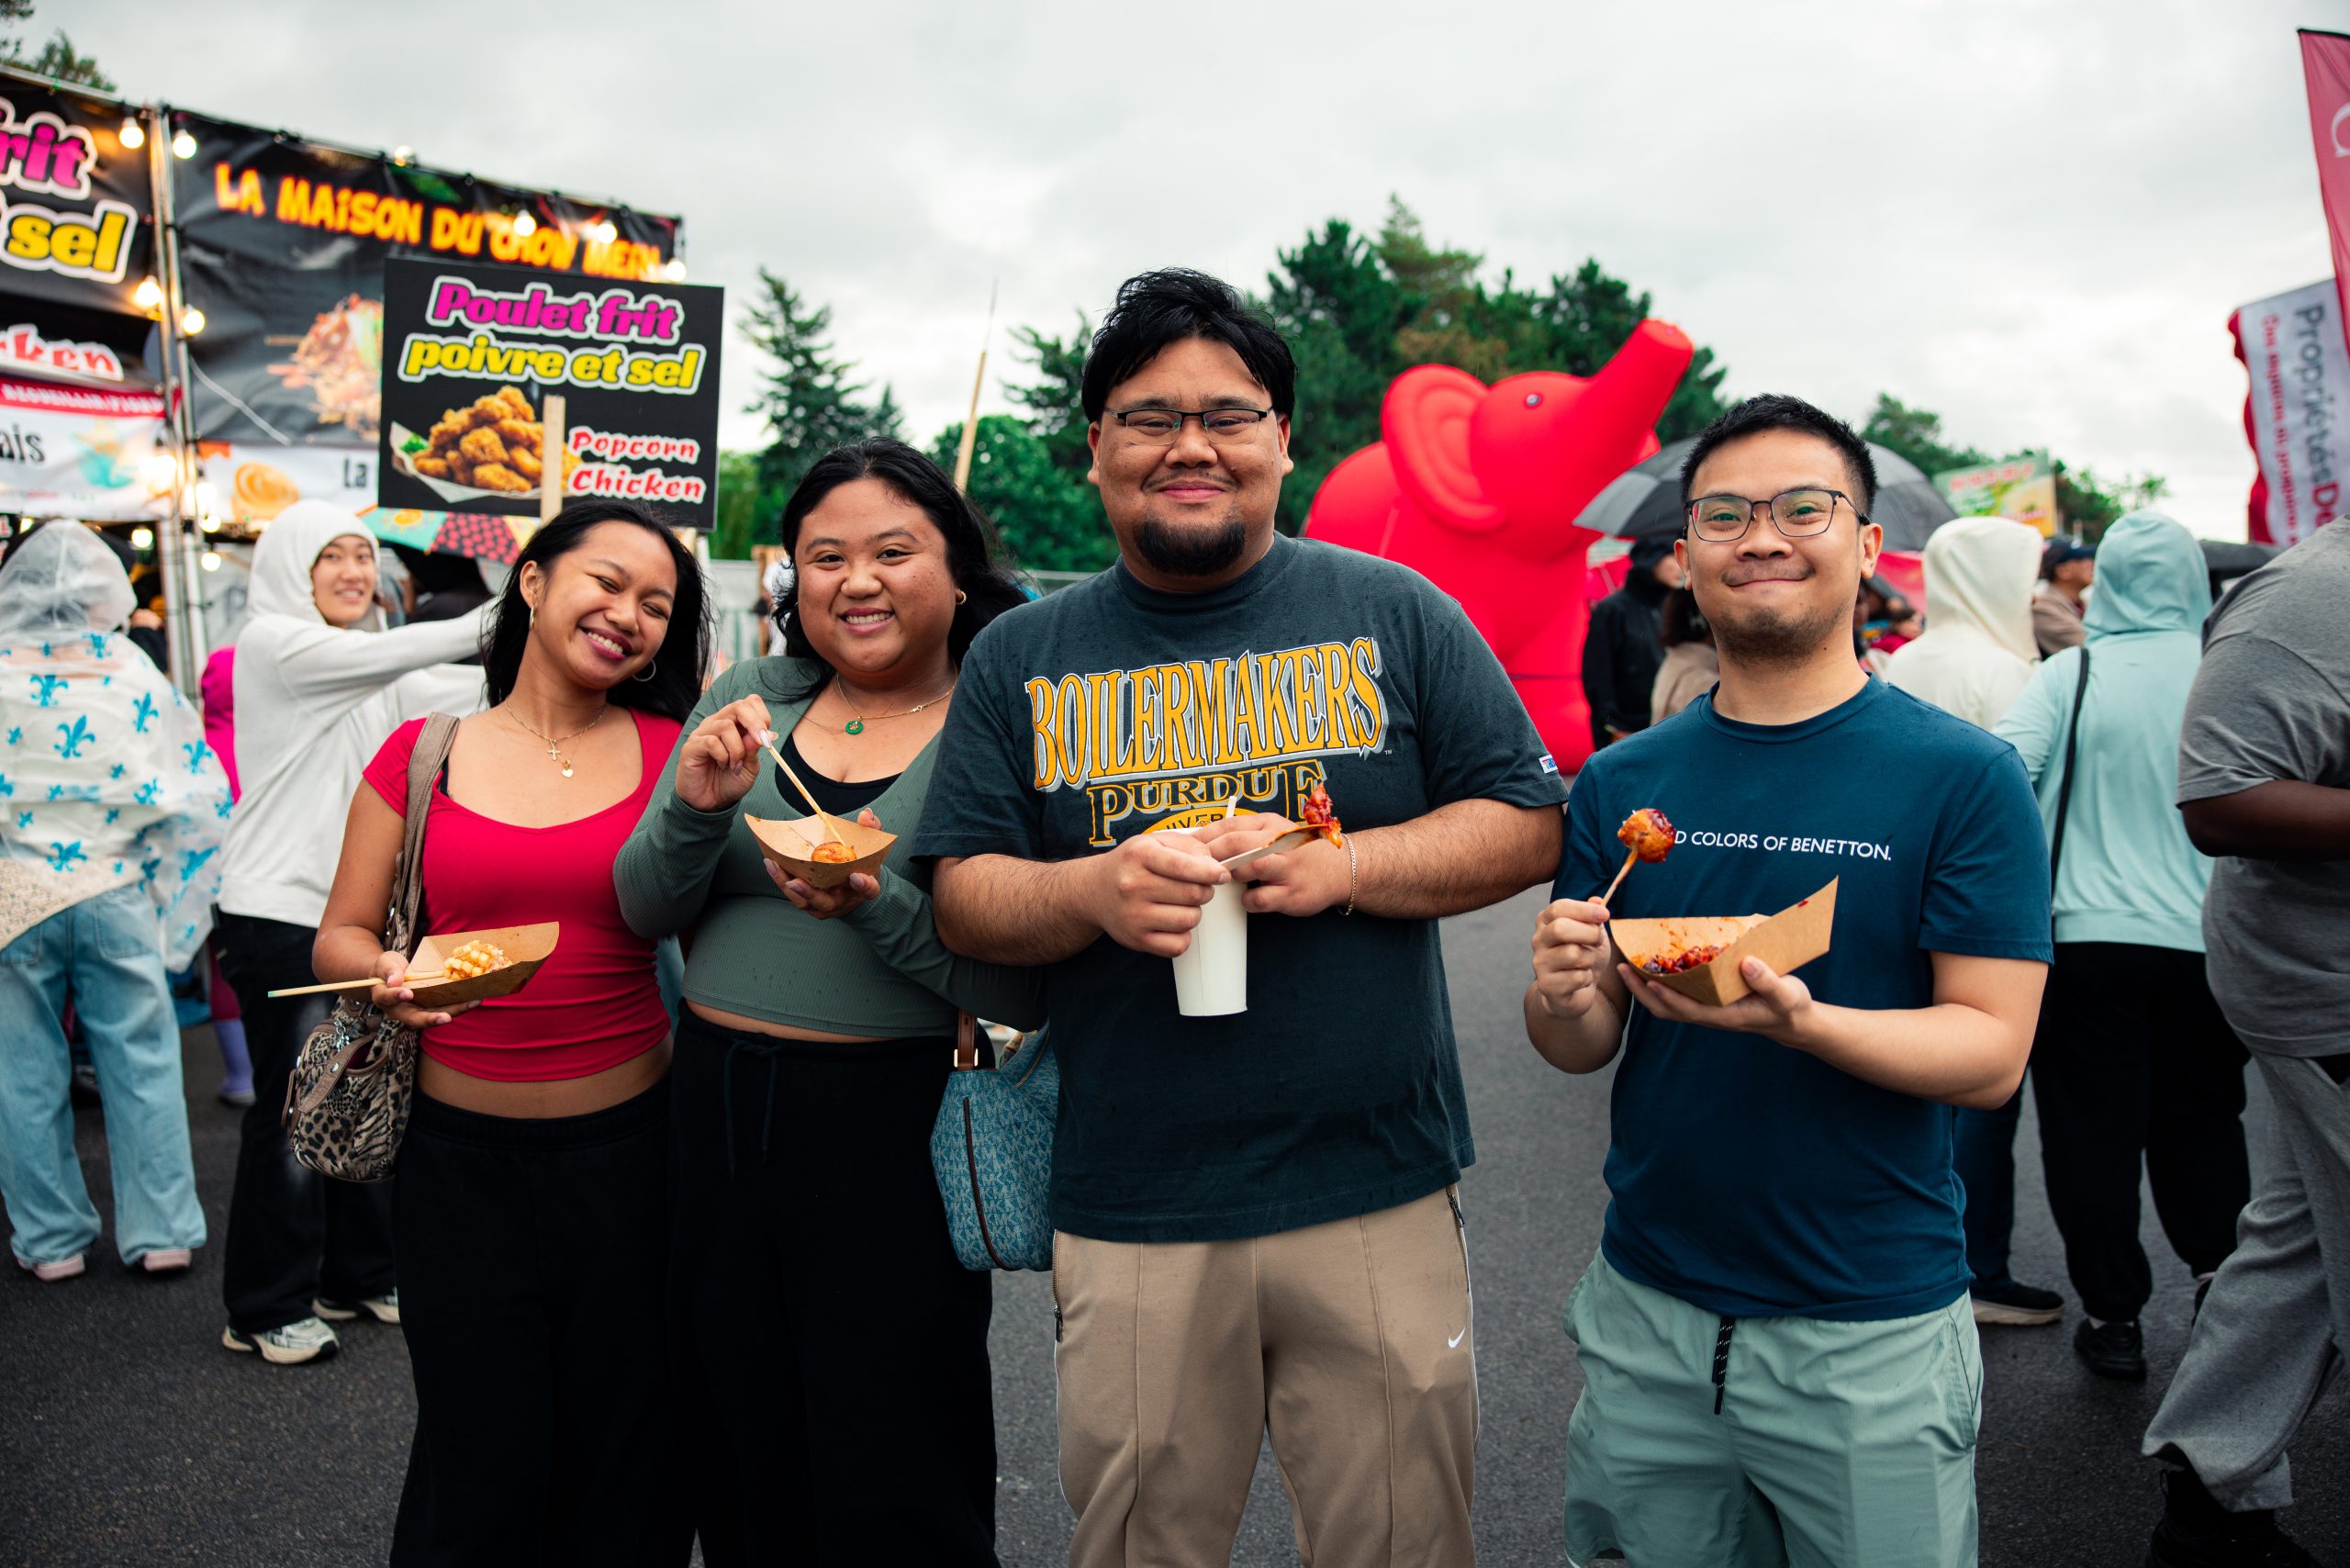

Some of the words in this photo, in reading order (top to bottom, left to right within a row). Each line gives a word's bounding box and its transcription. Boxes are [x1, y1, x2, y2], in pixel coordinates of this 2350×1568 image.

[0, 108, 87, 189] rit
[215, 162, 266, 217] LA
[431, 206, 487, 256] DU
[7, 210, 128, 273] sel
[432, 283, 591, 331] Poulet
[597, 296, 677, 339] frit
[405, 335, 566, 377] poivre
[571, 350, 623, 383] et
[627, 350, 700, 388] sel
[572, 431, 696, 458] Popcorn
[572, 469, 702, 498] Chicken
[1025, 637, 1385, 790] BOILERMAKERS
[1691, 831, 1758, 849] COLORS
[1762, 835, 1788, 852] OF
[1790, 837, 1892, 861] BENETTON.
